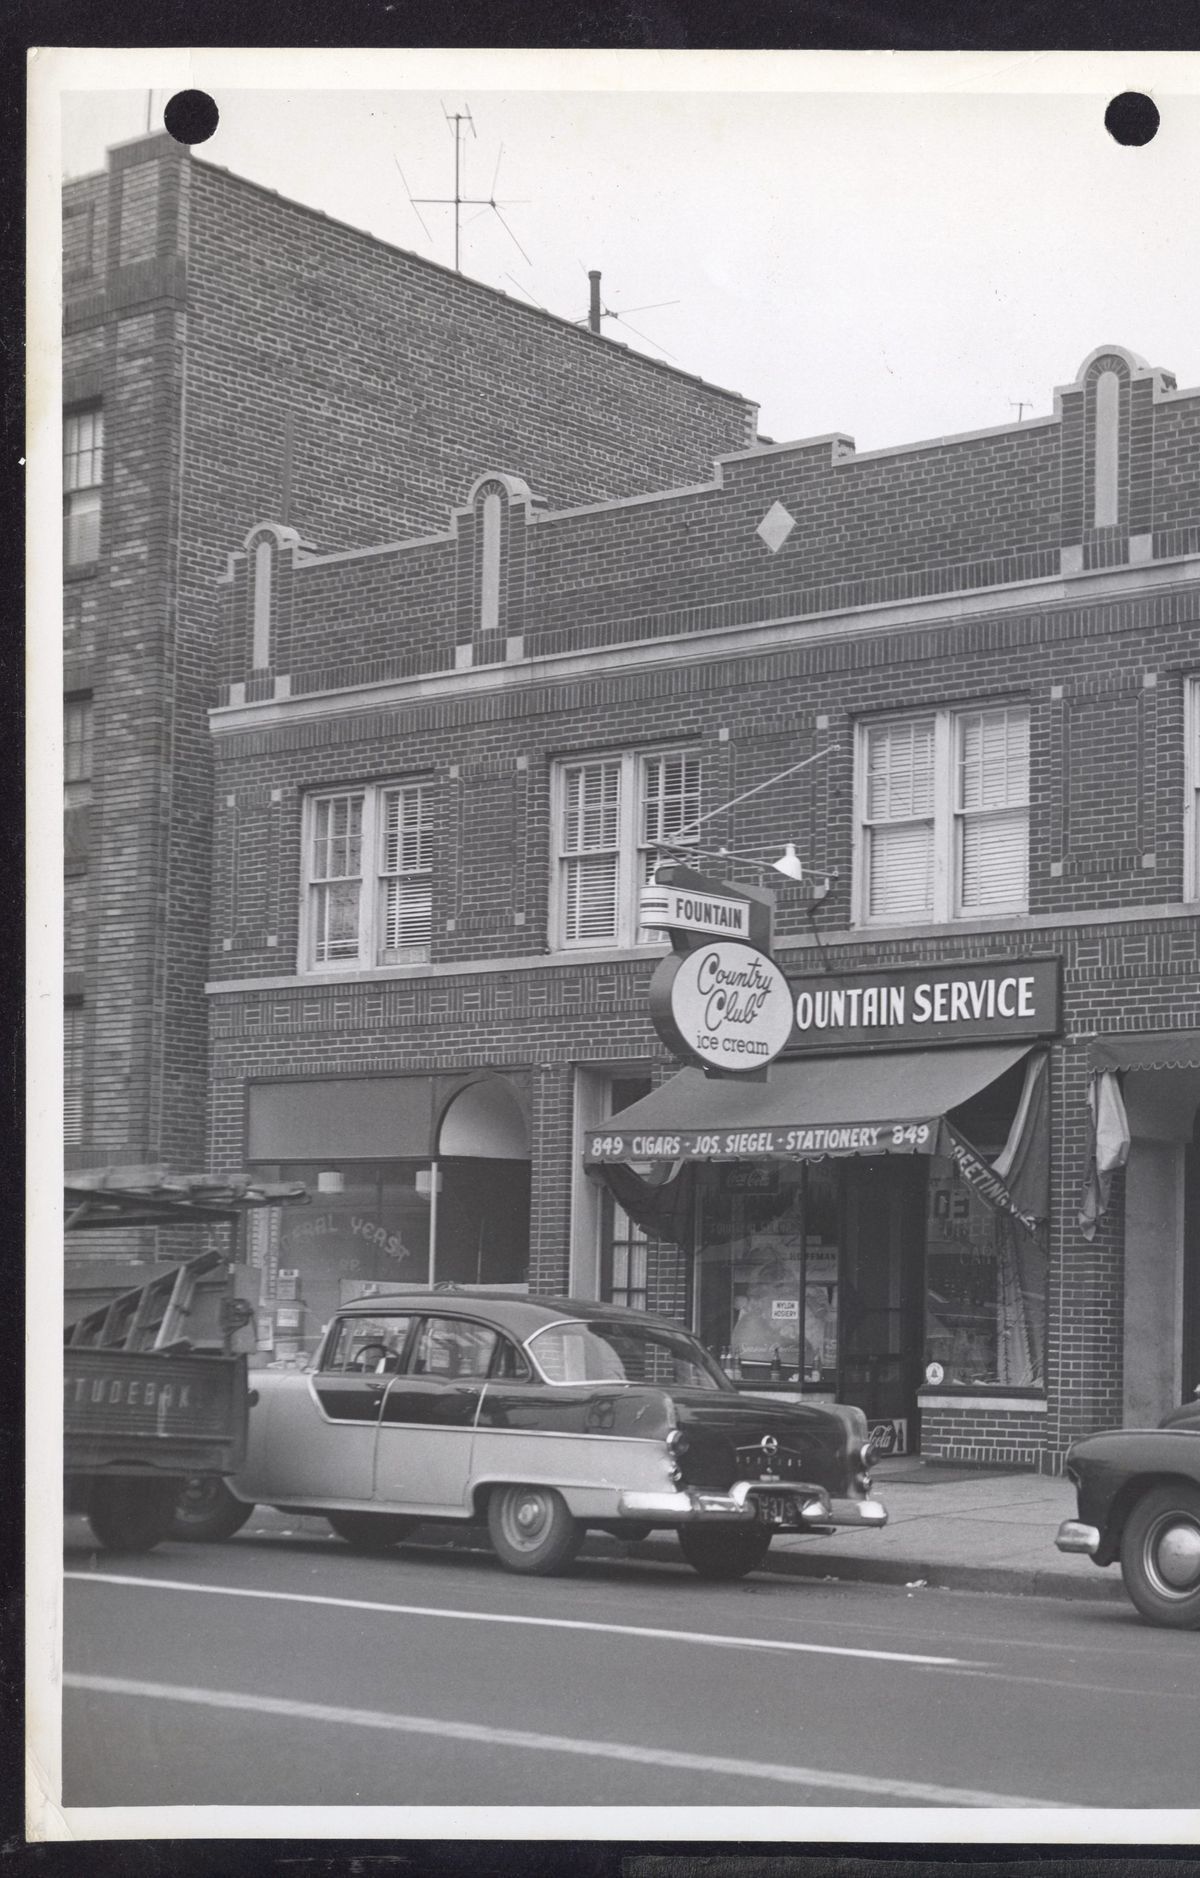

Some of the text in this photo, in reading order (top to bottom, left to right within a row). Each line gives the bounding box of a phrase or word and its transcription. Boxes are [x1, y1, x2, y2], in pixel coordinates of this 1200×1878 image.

[676, 898, 742, 929] FOUNTAIN
[697, 952, 773, 1008] Country
[705, 988, 758, 1031] Club
[796, 977, 1036, 1031] OUNTAIN SERVICE
[696, 1030, 769, 1056] ice cream
[591, 1125, 930, 1156] 849 CIGARS JOS. SIEGEL STATIONERY 849
[950, 1138, 1010, 1206] REETING
[350, 1215, 411, 1262] YEAST
[773, 1310, 797, 1318] HOSIERY
